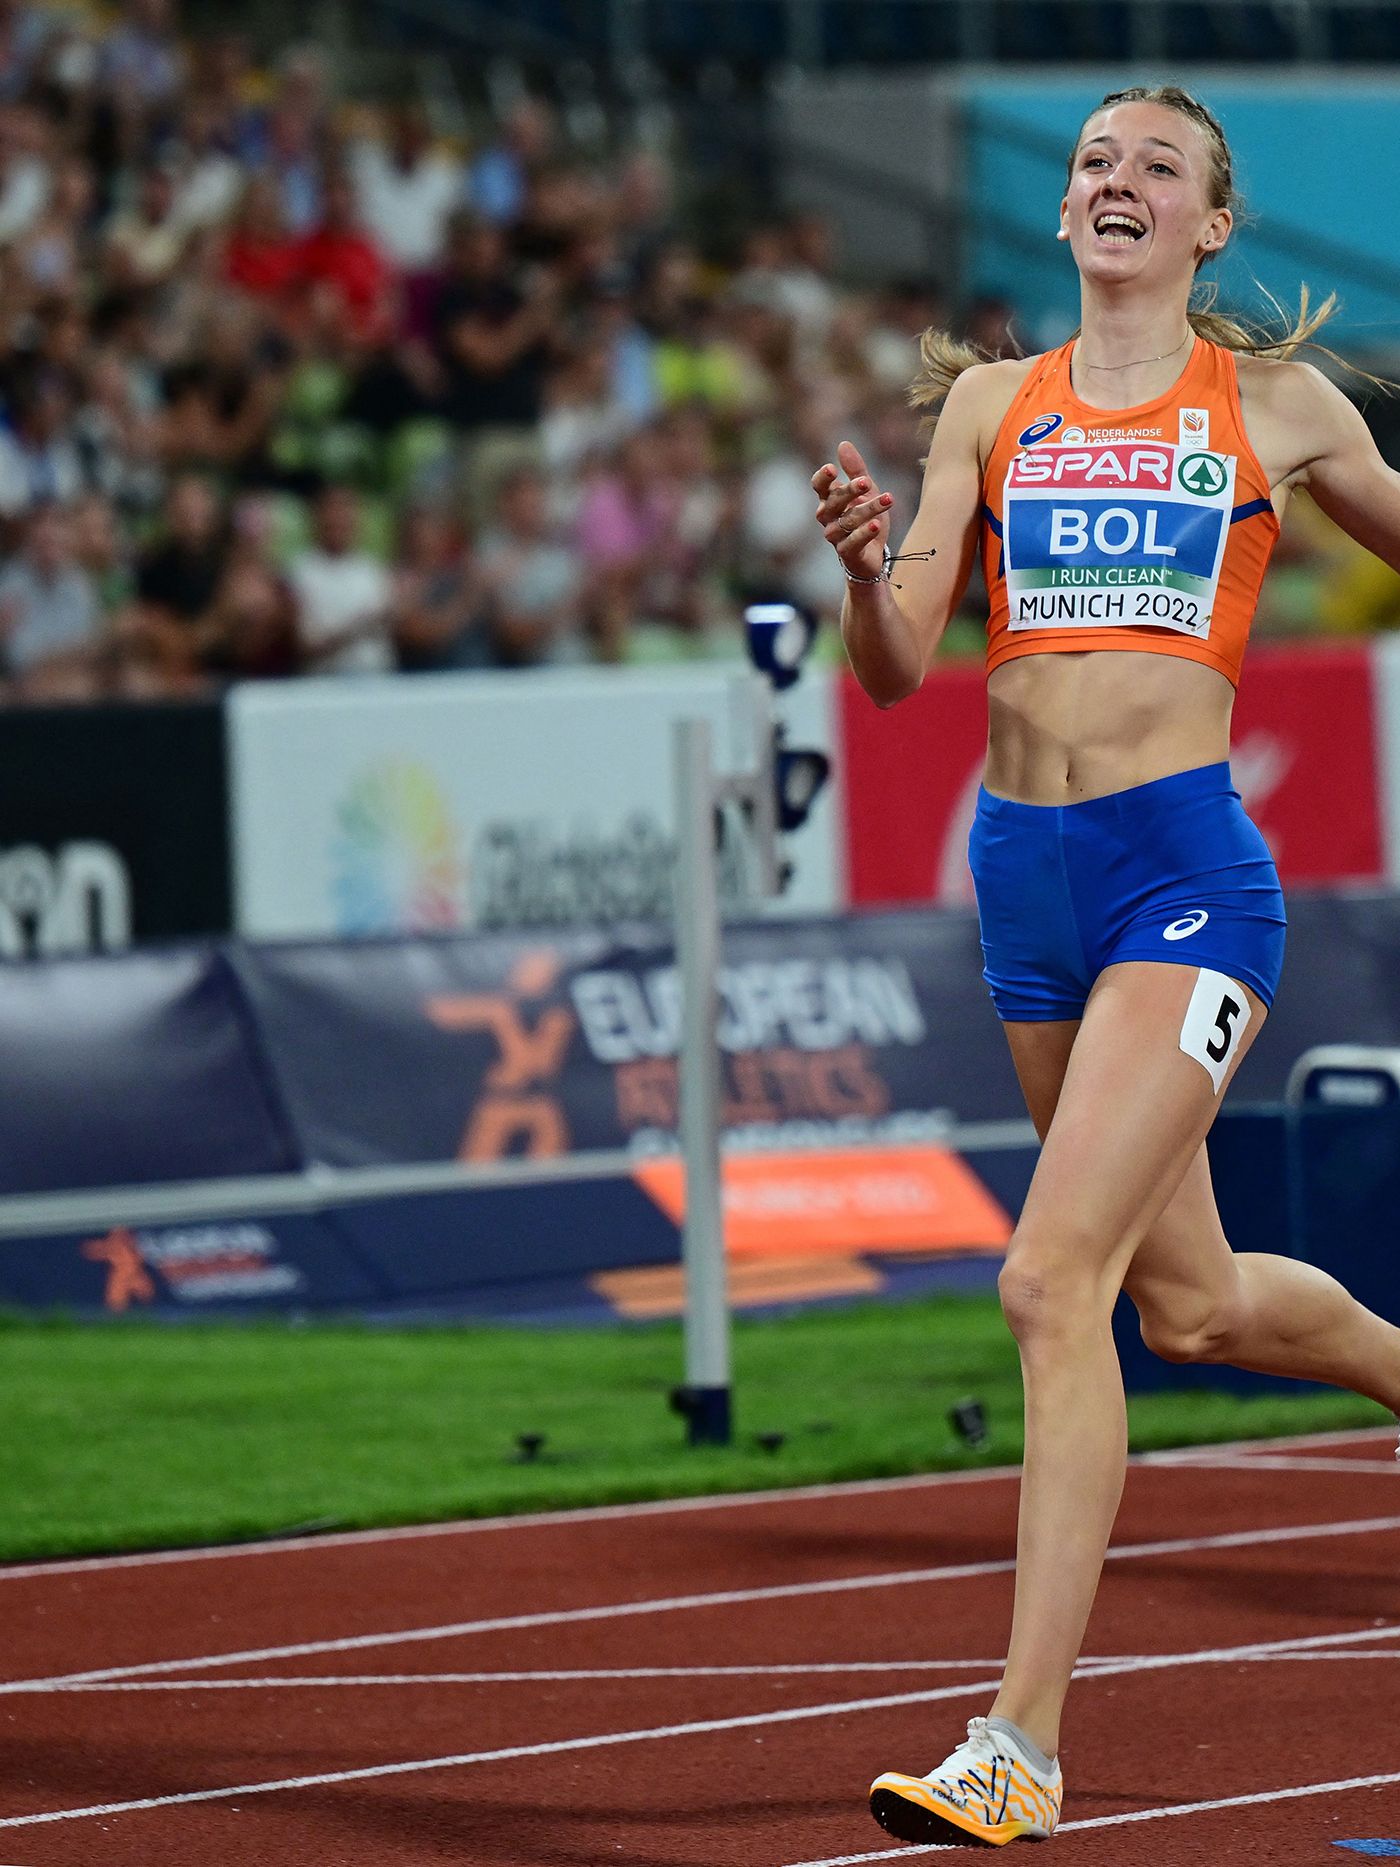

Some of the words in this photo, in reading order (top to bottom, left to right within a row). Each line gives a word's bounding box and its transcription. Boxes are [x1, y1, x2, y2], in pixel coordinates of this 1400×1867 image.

[1086, 428, 1163, 438] NEDERLANDSE
[1014, 450, 1170, 484] SPAR
[1049, 508, 1176, 557] BOL
[1051, 571, 1056, 585] I
[1061, 568, 1101, 585] RUN
[1019, 593, 1124, 622] MUNICH
[1135, 593, 1199, 627] 2022
[1207, 994, 1241, 1064] 5
